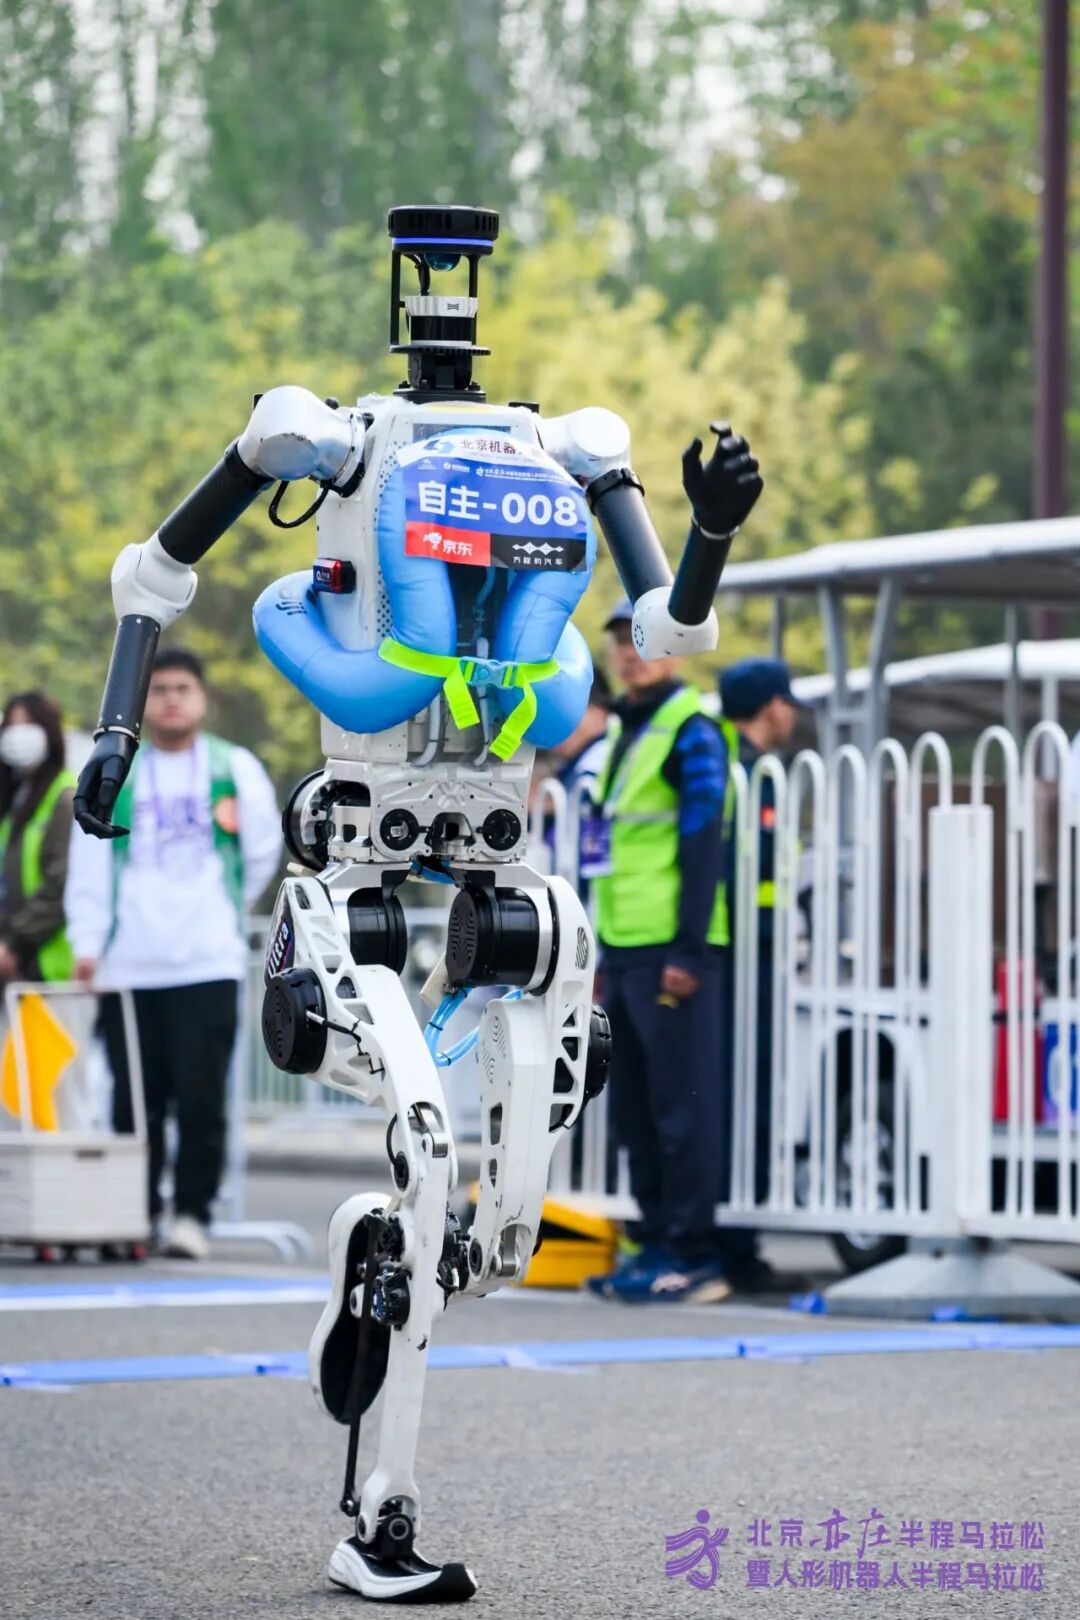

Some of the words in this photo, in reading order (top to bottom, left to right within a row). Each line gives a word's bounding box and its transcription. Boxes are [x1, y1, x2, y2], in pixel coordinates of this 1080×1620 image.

[461, 439, 523, 456] 北京机器
[418, 480, 578, 527] 自主-008
[442, 538, 473, 557] 京东
